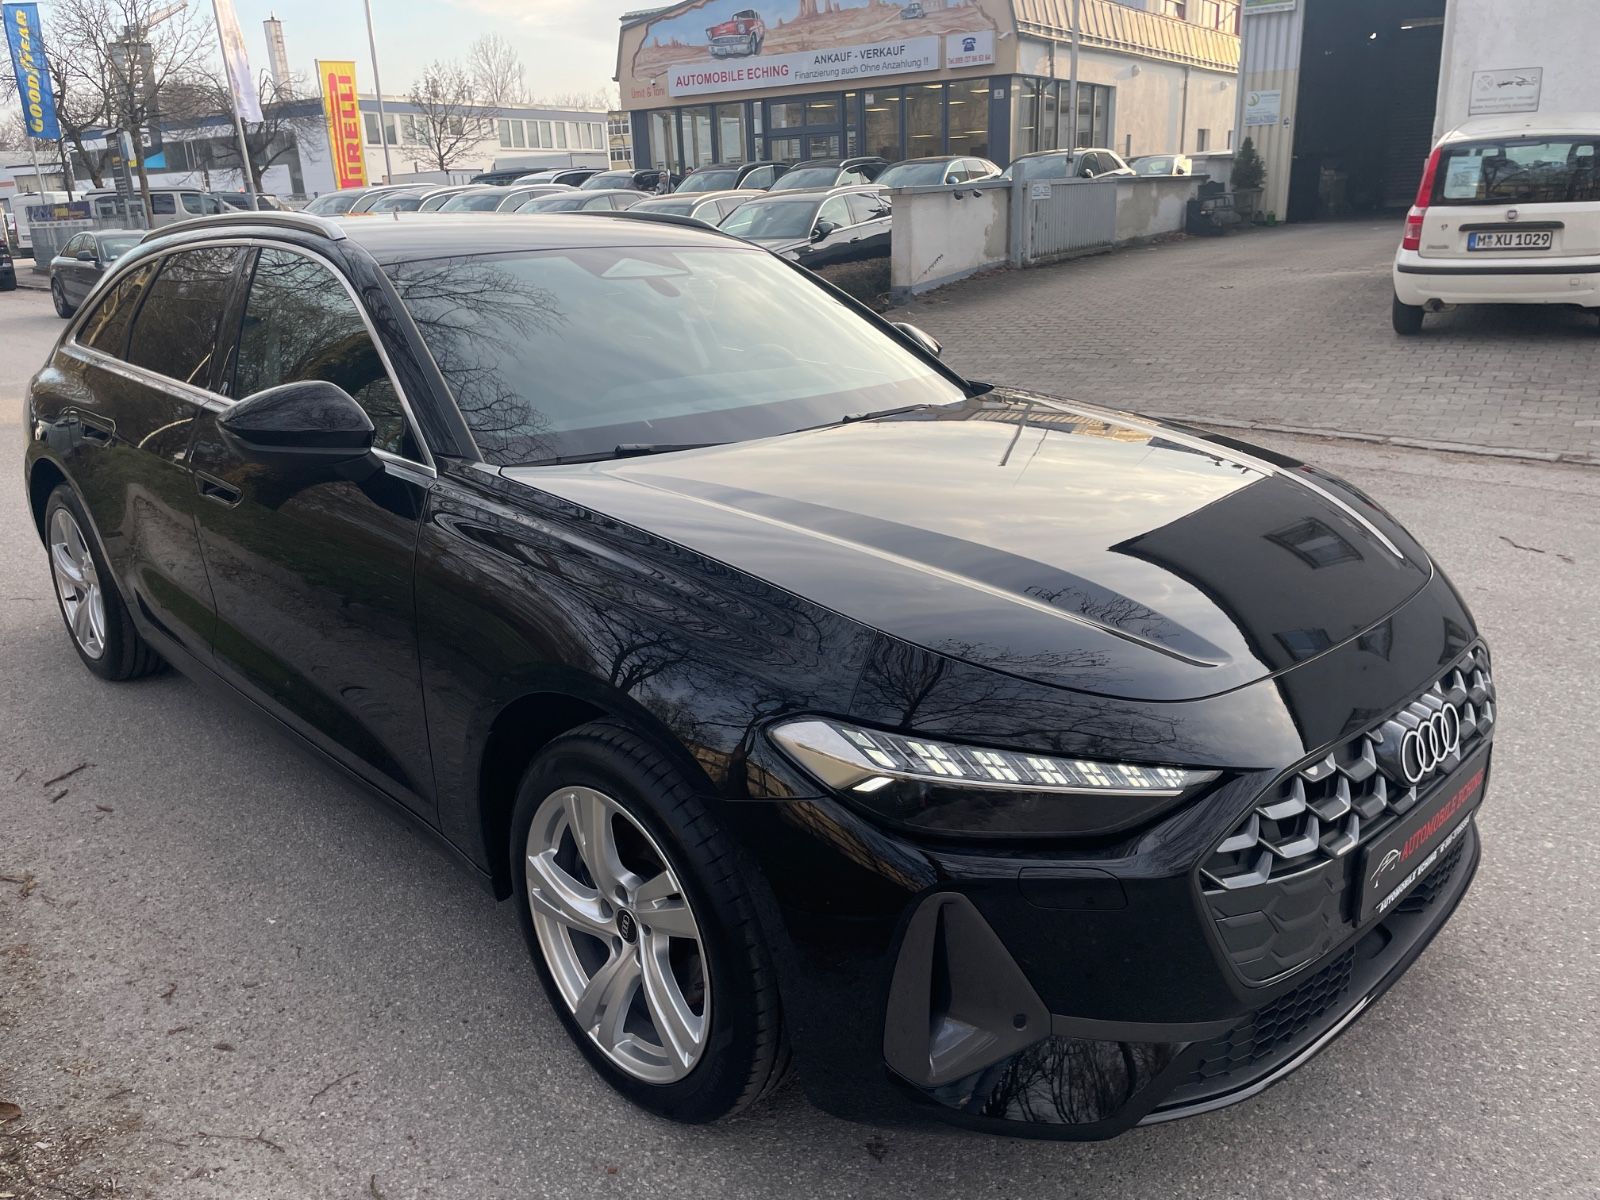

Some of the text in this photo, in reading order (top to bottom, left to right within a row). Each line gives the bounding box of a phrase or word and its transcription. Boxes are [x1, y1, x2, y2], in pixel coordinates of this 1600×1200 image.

[814, 52, 852, 65] ANKAUF
[859, 45, 906, 60] VERKAUF
[16, 9, 44, 133] GOODYEAR
[675, 64, 789, 88] AUTOMOBILE ECHING
[794, 66, 840, 81] Finanzierung
[841, 65, 859, 75] auch
[860, 62, 880, 73] Ohne
[881, 57, 922, 71] Anzahlung
[328, 72, 364, 189] PIRELLI
[1476, 233, 1550, 247] M XU 1029
